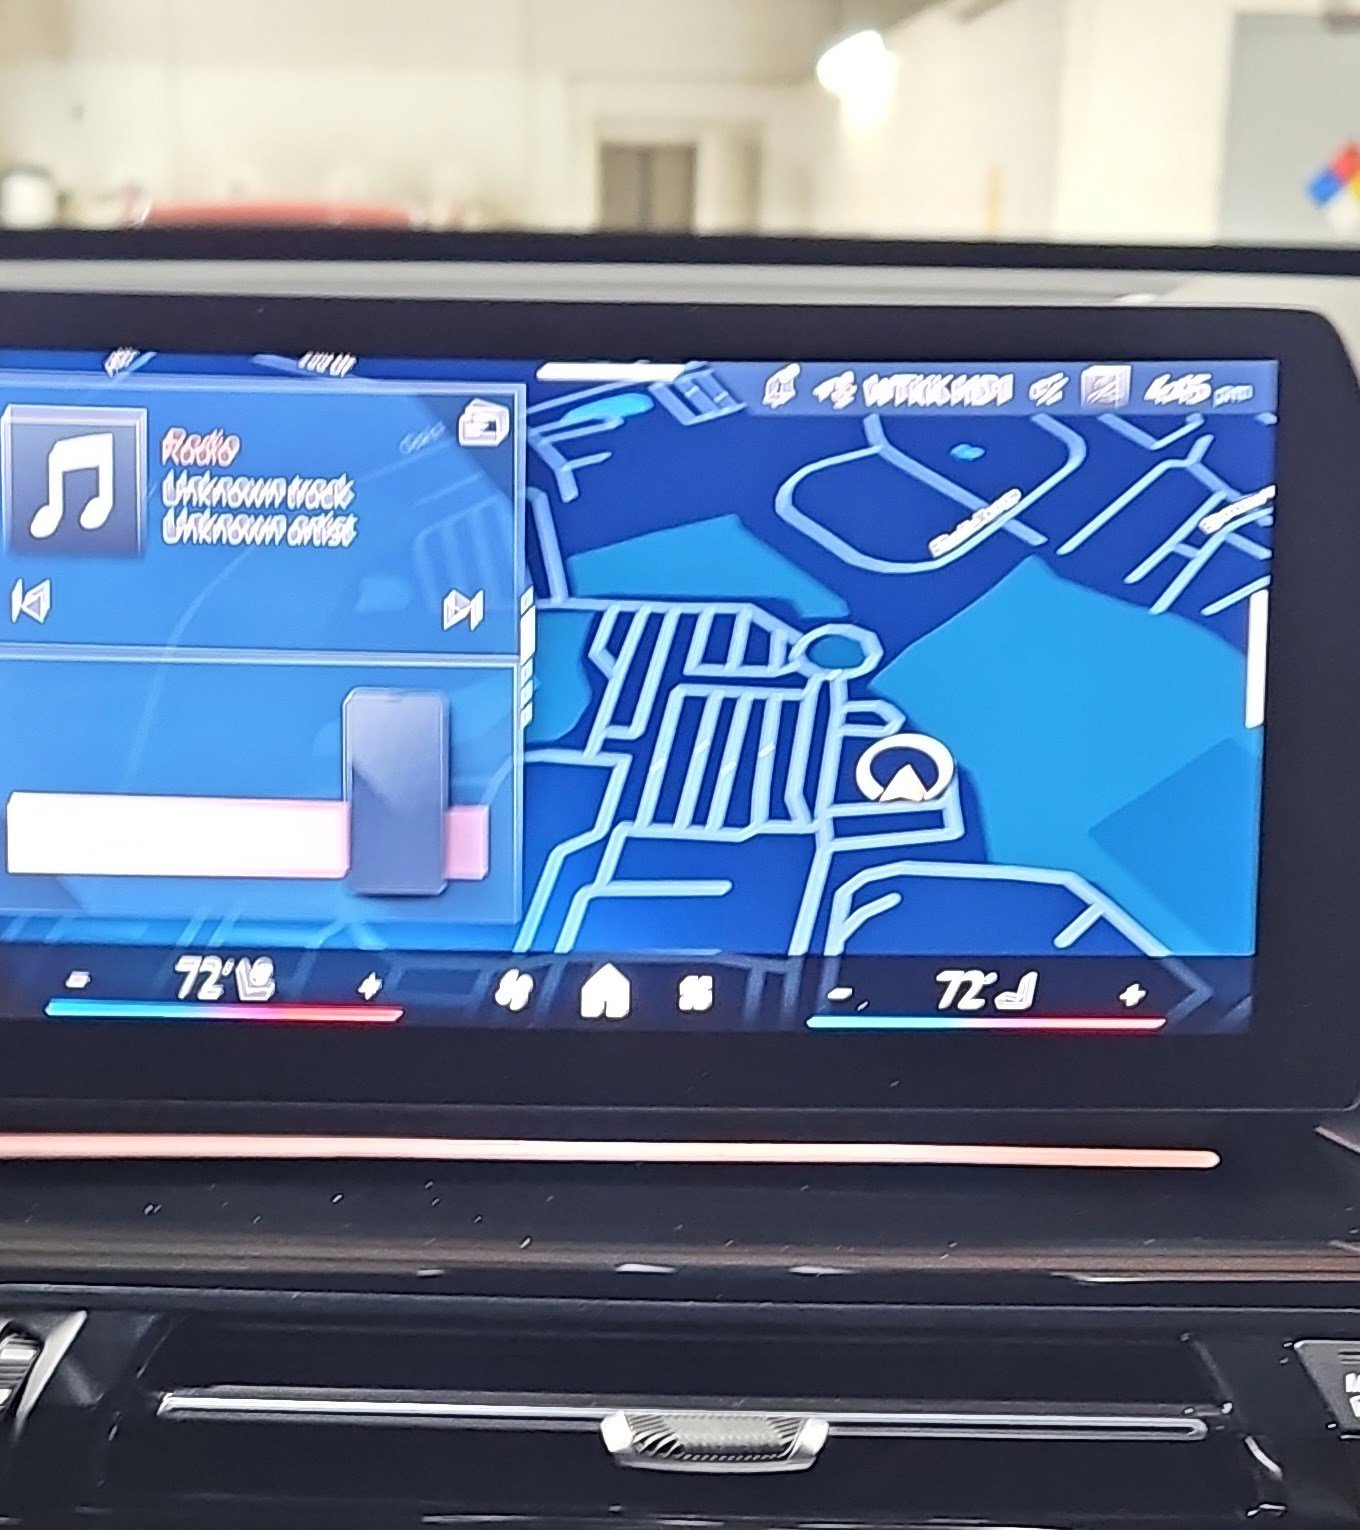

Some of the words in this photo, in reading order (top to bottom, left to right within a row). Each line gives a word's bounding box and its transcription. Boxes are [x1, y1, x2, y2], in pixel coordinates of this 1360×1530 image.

[162, 427, 240, 467] Radio
[162, 469, 287, 508] Unknown
[287, 473, 355, 510] track
[162, 506, 287, 545] Unknown
[287, 510, 358, 548] artist
